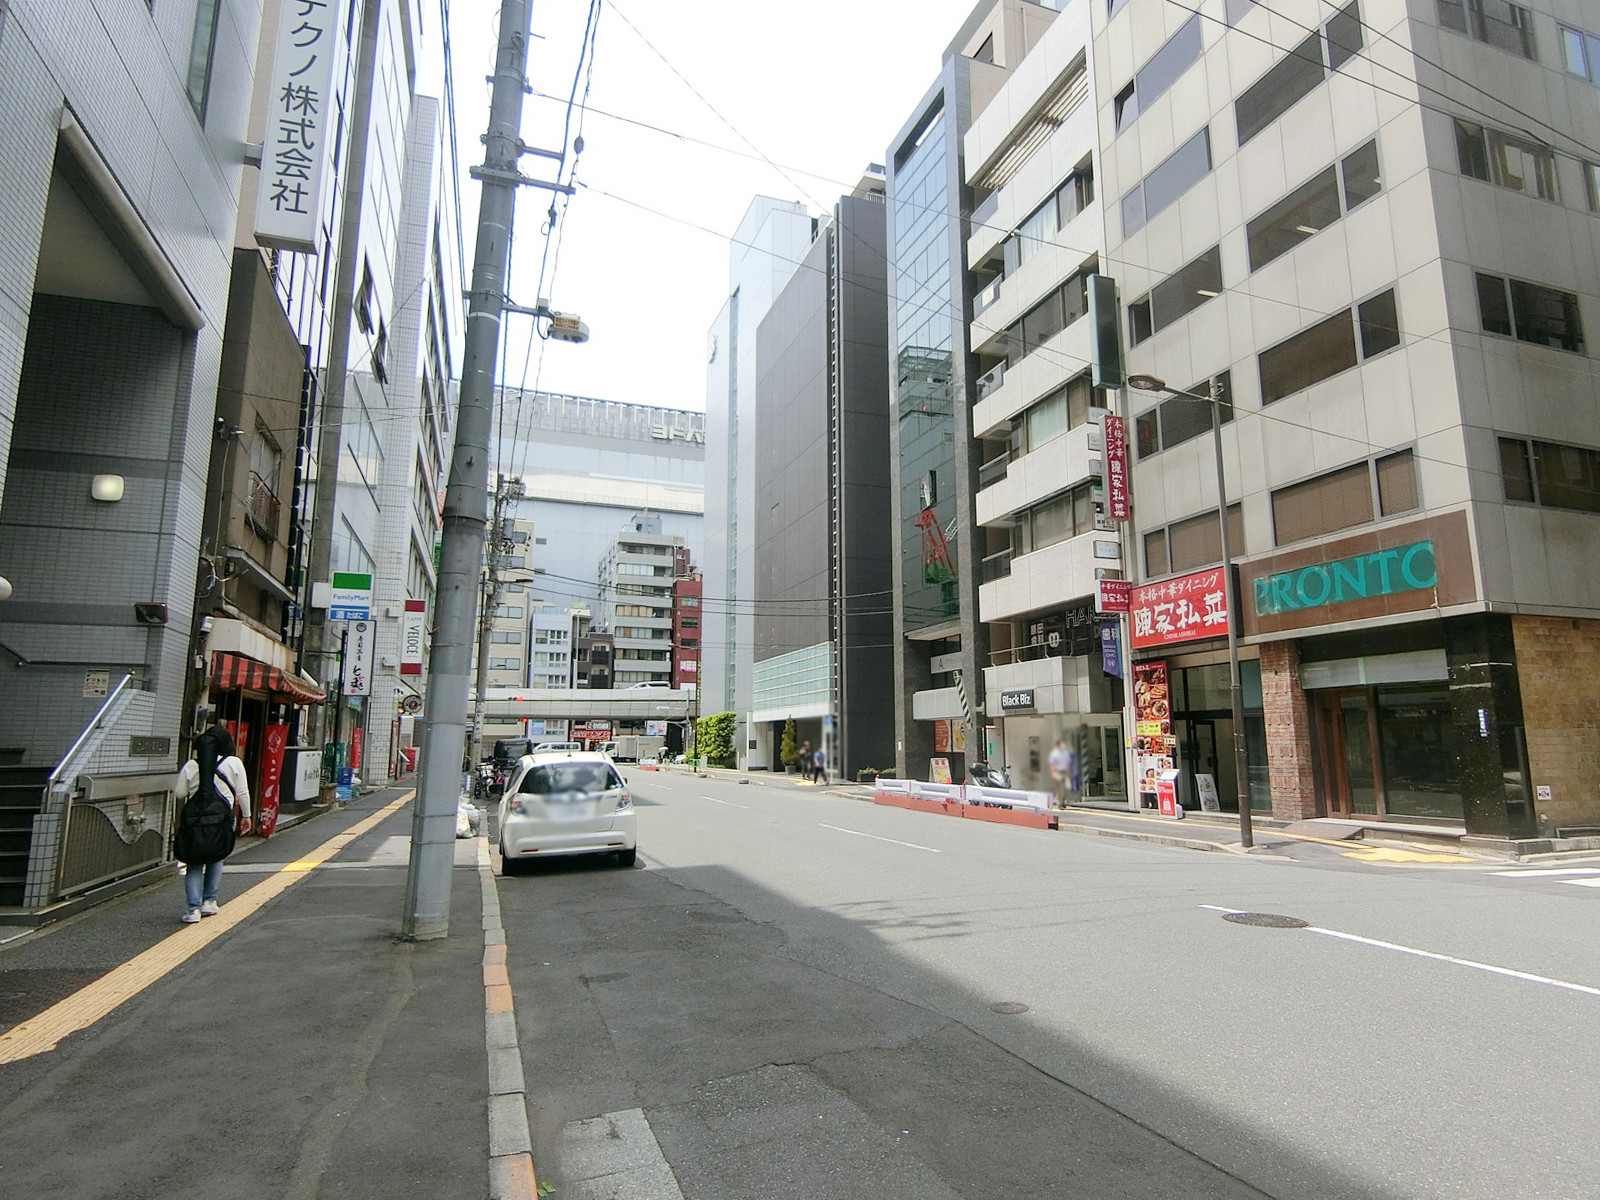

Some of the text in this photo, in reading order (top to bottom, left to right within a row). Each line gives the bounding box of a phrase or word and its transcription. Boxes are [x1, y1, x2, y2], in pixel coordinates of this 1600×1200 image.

[1106, 418, 1115, 459] ダイニング
[1113, 418, 1125, 458] 本格中華
[1110, 460, 1126, 517] 陳家私菜
[333, 593, 369, 602] FamilyMart
[1101, 592, 1129, 604] 陳家私
[1139, 572, 1219, 604] 本格中華ダイニング
[1134, 589, 1227, 638] 陳家私菜
[406, 625, 420, 654] VELOCE
[1101, 627, 1120, 641] 歯科
[1002, 692, 1031, 706] Black Biz
